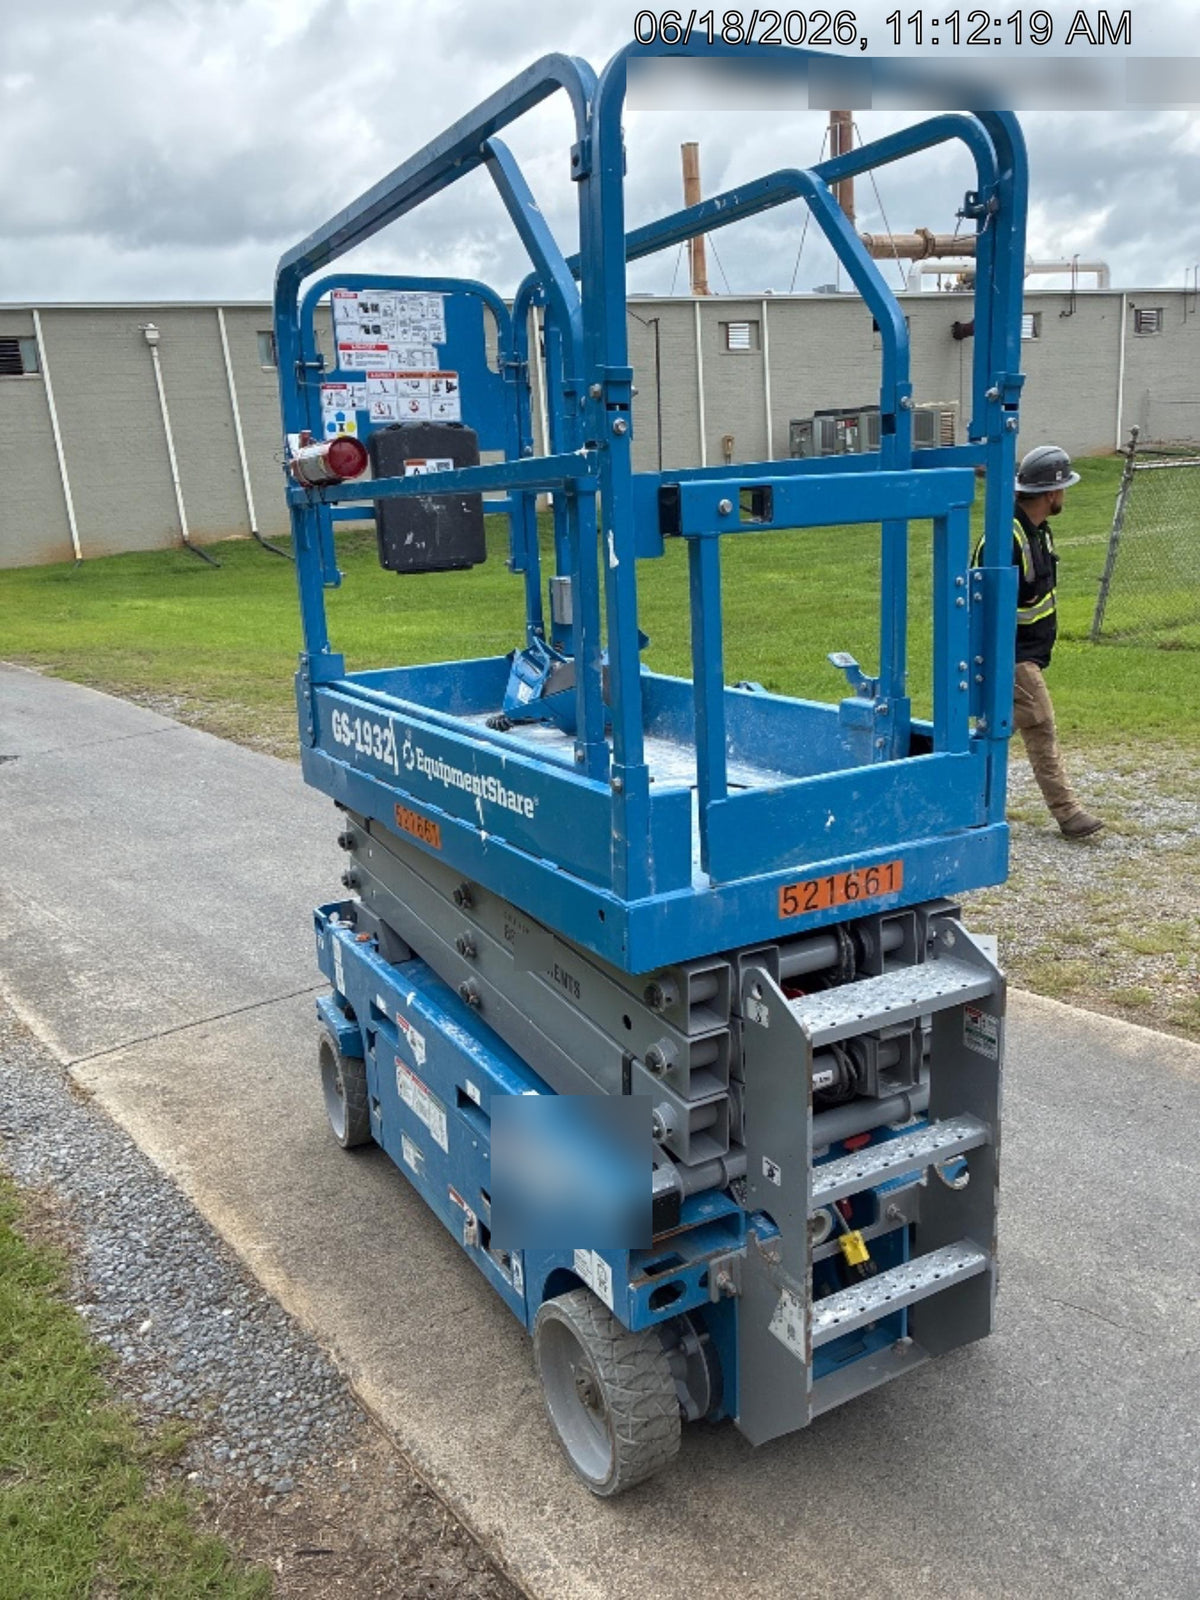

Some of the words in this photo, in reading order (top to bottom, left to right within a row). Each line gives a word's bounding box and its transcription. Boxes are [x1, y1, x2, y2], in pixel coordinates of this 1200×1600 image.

[331, 708, 393, 766] GS-1932
[415, 748, 535, 819] EquipmentShare
[782, 864, 896, 916] 521661
